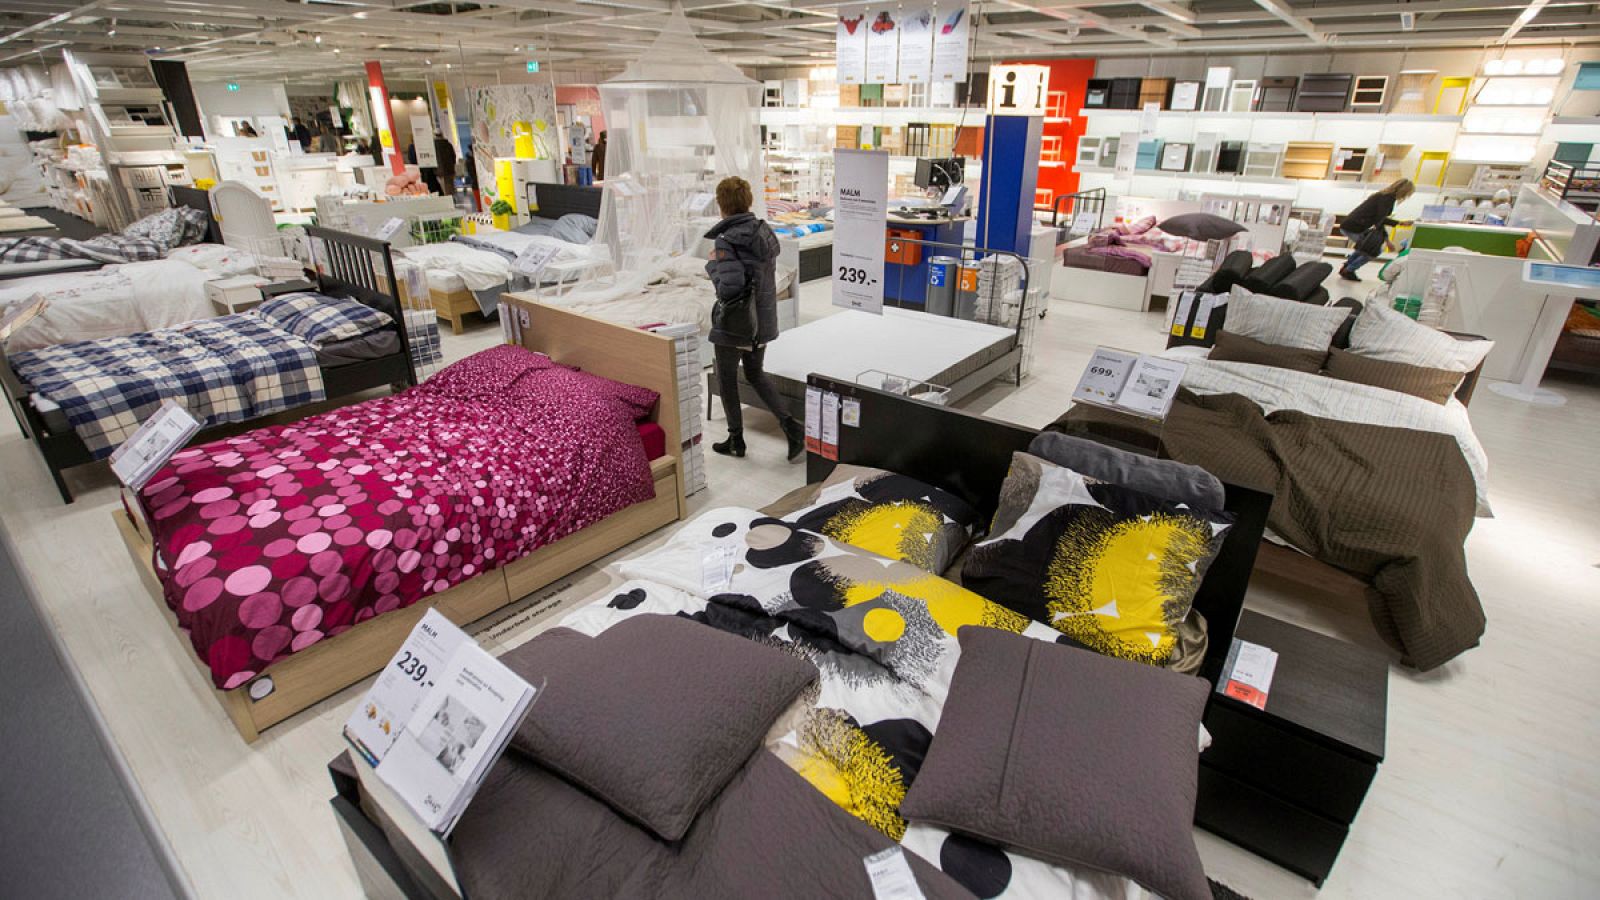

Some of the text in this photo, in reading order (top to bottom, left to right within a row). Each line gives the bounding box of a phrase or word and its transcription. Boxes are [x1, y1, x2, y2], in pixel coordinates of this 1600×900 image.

[1000, 71, 1017, 108] i
[840, 187, 861, 197] MALM
[838, 266, 877, 286] 239.-
[420, 623, 439, 639] MALM
[489, 615, 531, 641] Underbed
[531, 599, 562, 617] storage
[396, 651, 435, 688] 239.-
